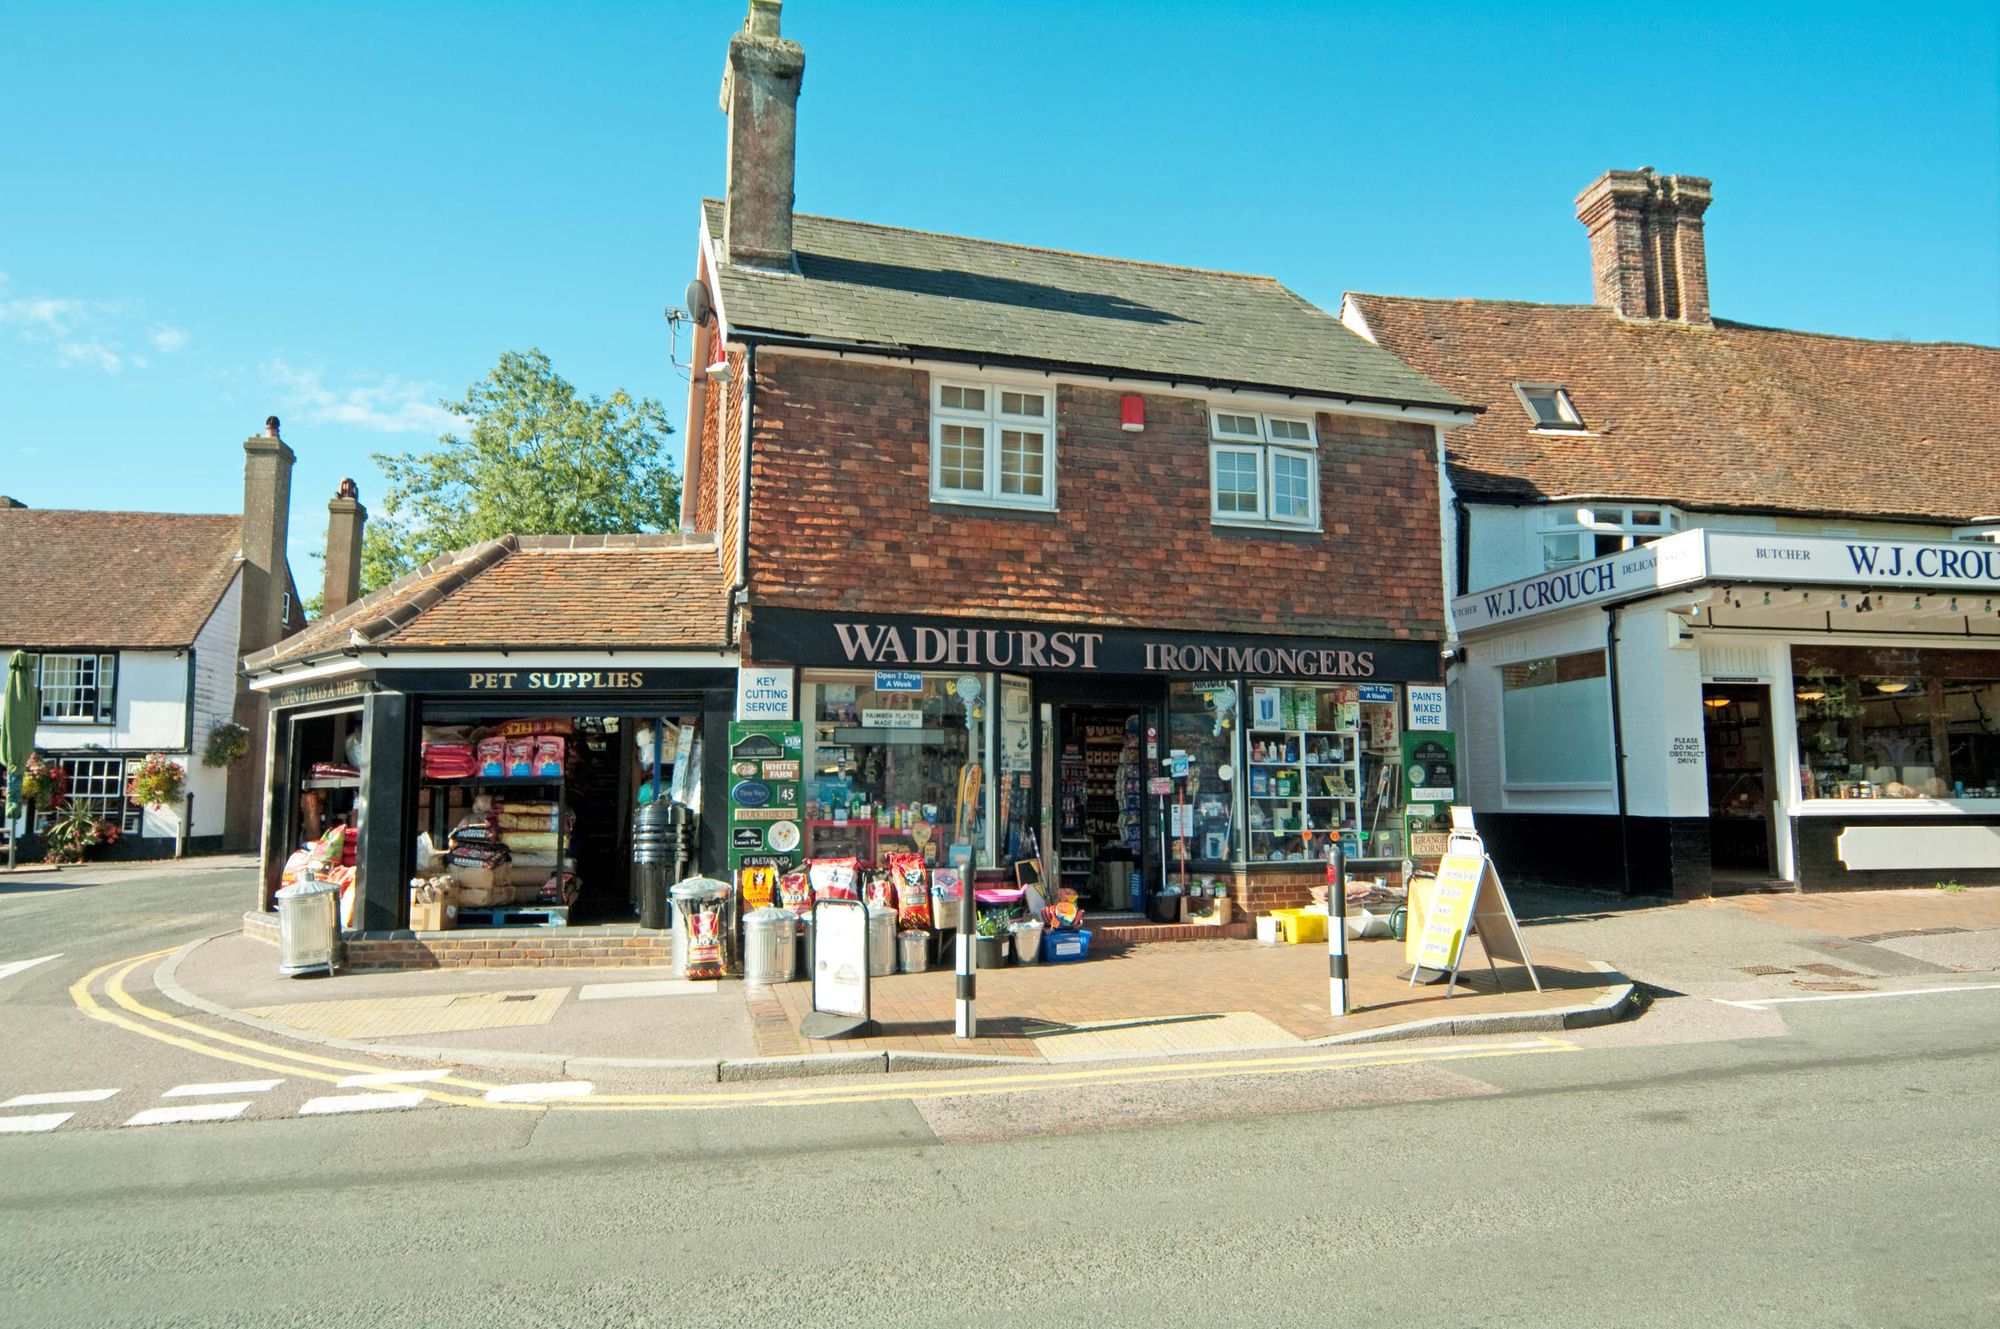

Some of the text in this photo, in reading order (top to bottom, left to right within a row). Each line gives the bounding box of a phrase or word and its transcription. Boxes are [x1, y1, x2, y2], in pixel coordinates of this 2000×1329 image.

[1756, 544, 2000, 580] BUTCHER W.J.CROU
[833, 623, 1375, 677] WADHURST IRONMONGERS
[469, 672, 644, 689] PET SUPPLIES
[756, 676, 777, 687] KEY
[877, 672, 896, 680] Open
[903, 673, 921, 681] Days
[1193, 680, 1226, 689] NIKWAX
[280, 680, 360, 705] OPEN 7 DAYS A WEEK
[745, 689, 788, 699] CUTTING
[1411, 691, 1442, 701] PAINTS
[745, 702, 788, 712] SERVICE
[1413, 704, 1442, 713] MIXED
[865, 712, 893, 720] NUMBER
[1415, 715, 1440, 725] HERE
[765, 763, 798, 771] WHITES
[769, 770, 793, 778] FARM
[781, 789, 794, 800] 45
